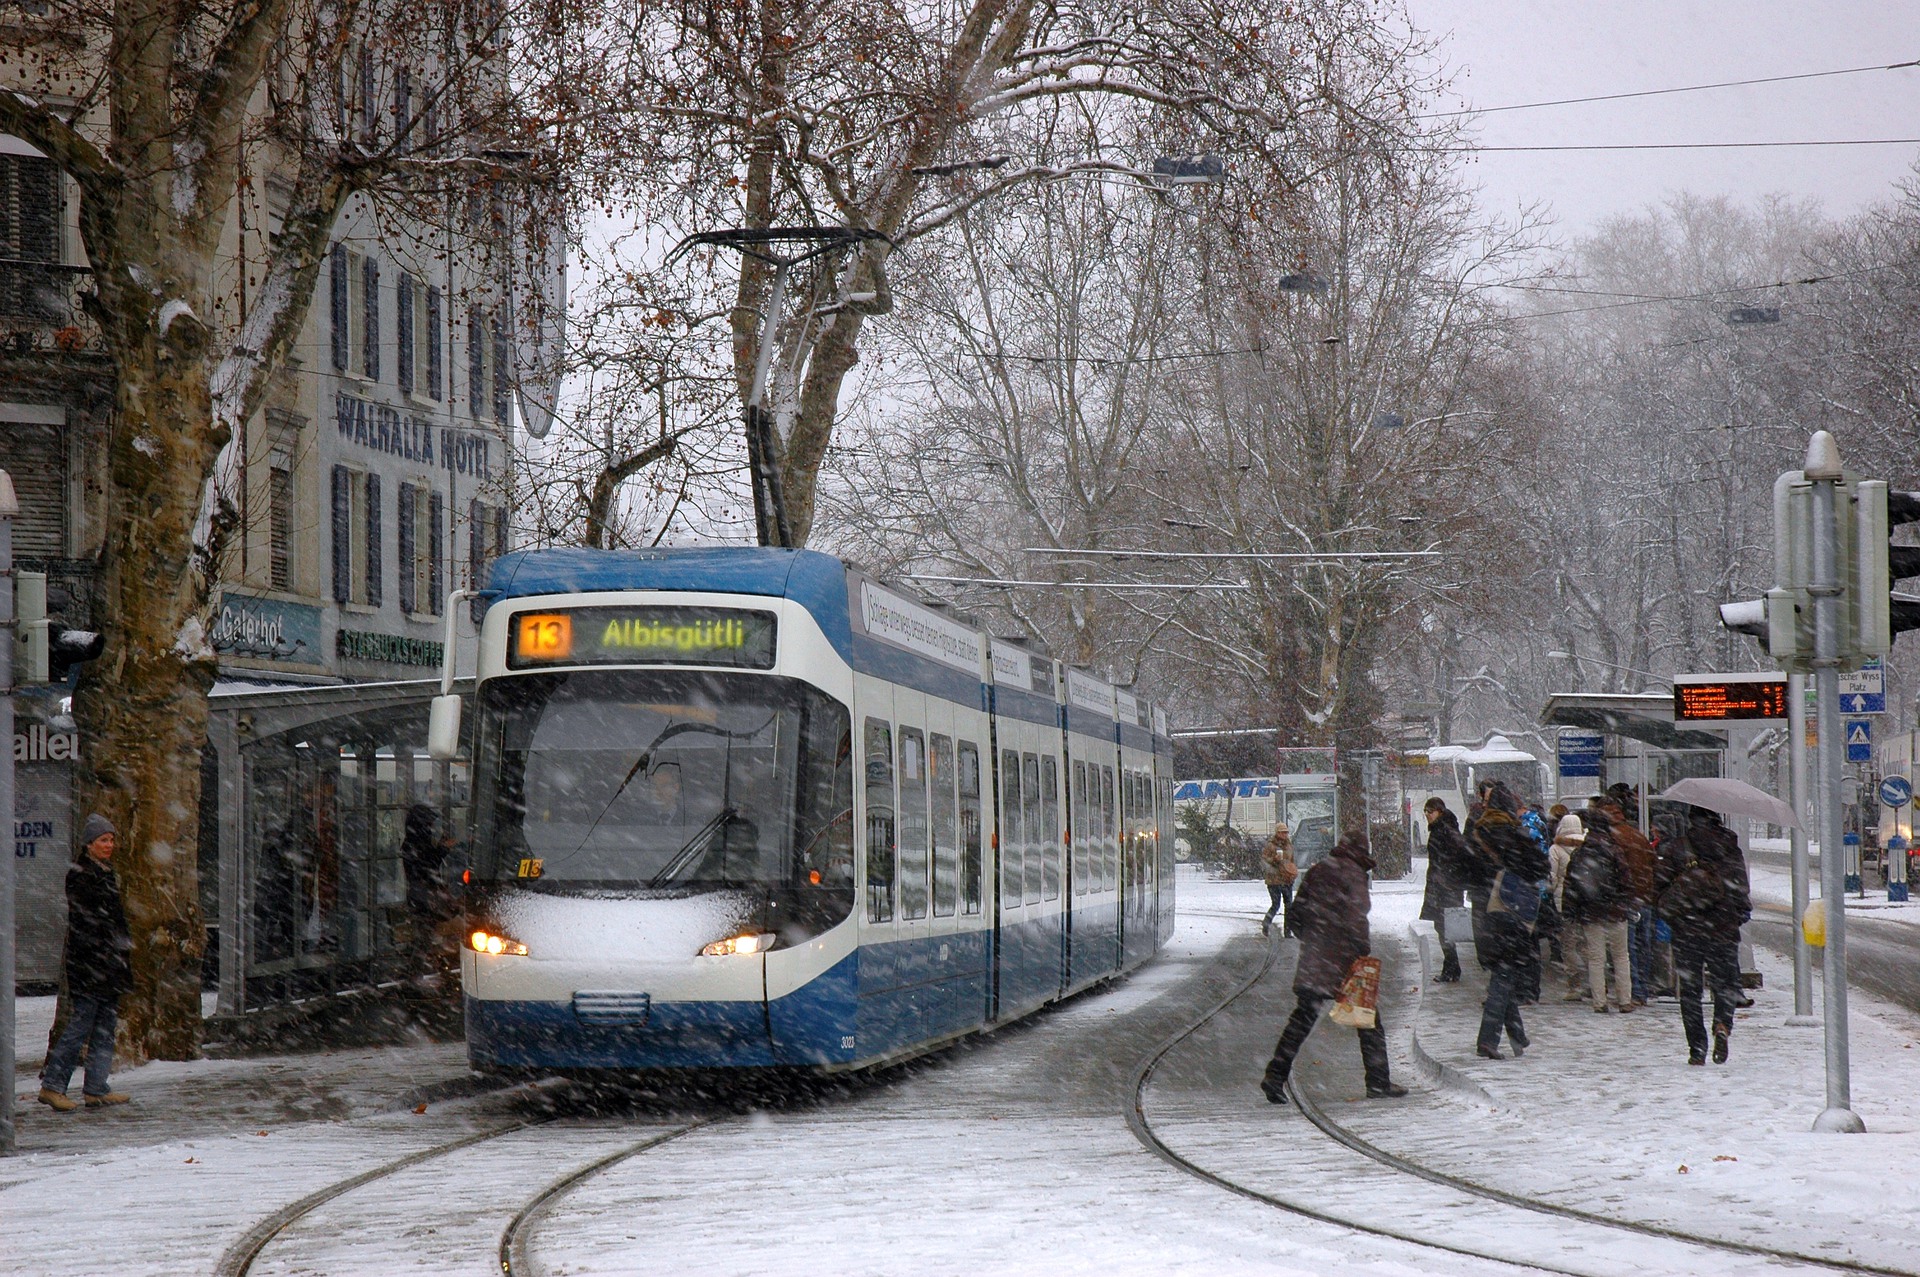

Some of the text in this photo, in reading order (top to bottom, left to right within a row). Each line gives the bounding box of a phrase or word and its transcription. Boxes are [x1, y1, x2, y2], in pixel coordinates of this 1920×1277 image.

[336, 395, 492, 480] WALHALLA HOTEL
[526, 618, 744, 650] 13 Albisgütli
[343, 628, 445, 667] STARBUCKS COFFE
[1839, 671, 1880, 682] scher Wyss
[1849, 683, 1867, 692] Platz
[14, 821, 53, 838] LDEN
[15, 842, 37, 858] UT
[521, 860, 542, 876] 13
